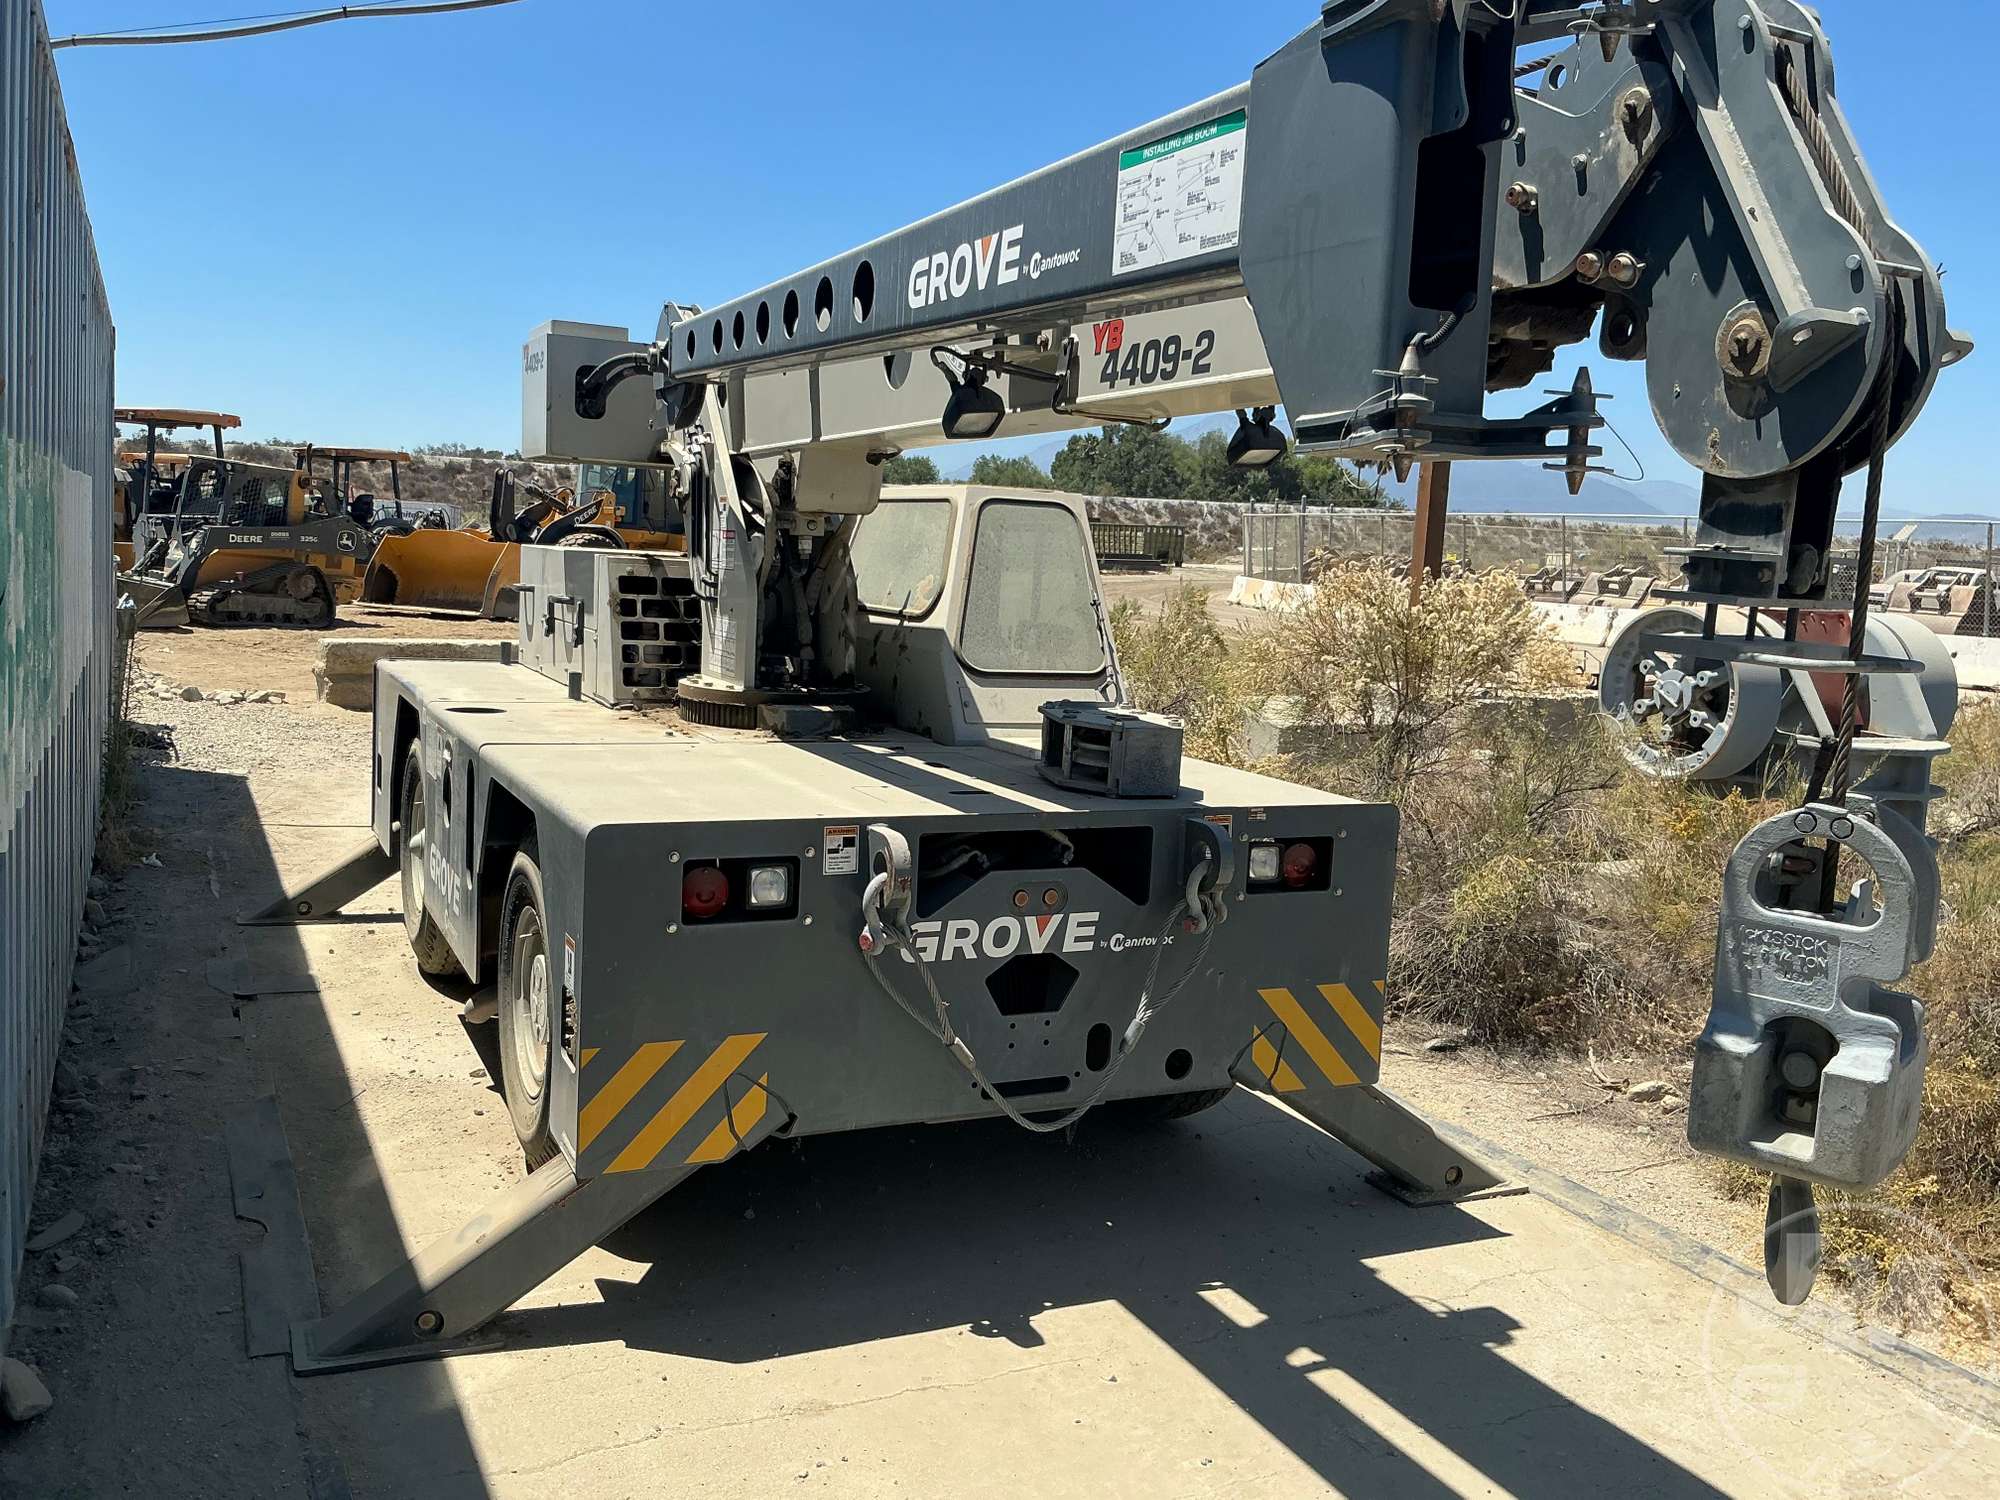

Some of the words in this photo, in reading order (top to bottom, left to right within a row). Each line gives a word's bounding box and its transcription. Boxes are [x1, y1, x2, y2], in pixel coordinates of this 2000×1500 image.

[1143, 138, 1181, 159] INSTALLING
[908, 224, 1023, 309] GROVE
[1093, 318, 1125, 356] YB
[1100, 329, 1216, 389] 4409-2
[229, 533, 263, 543] DEERE
[429, 842, 461, 917] GROVE
[900, 911, 1100, 964] GROVE
